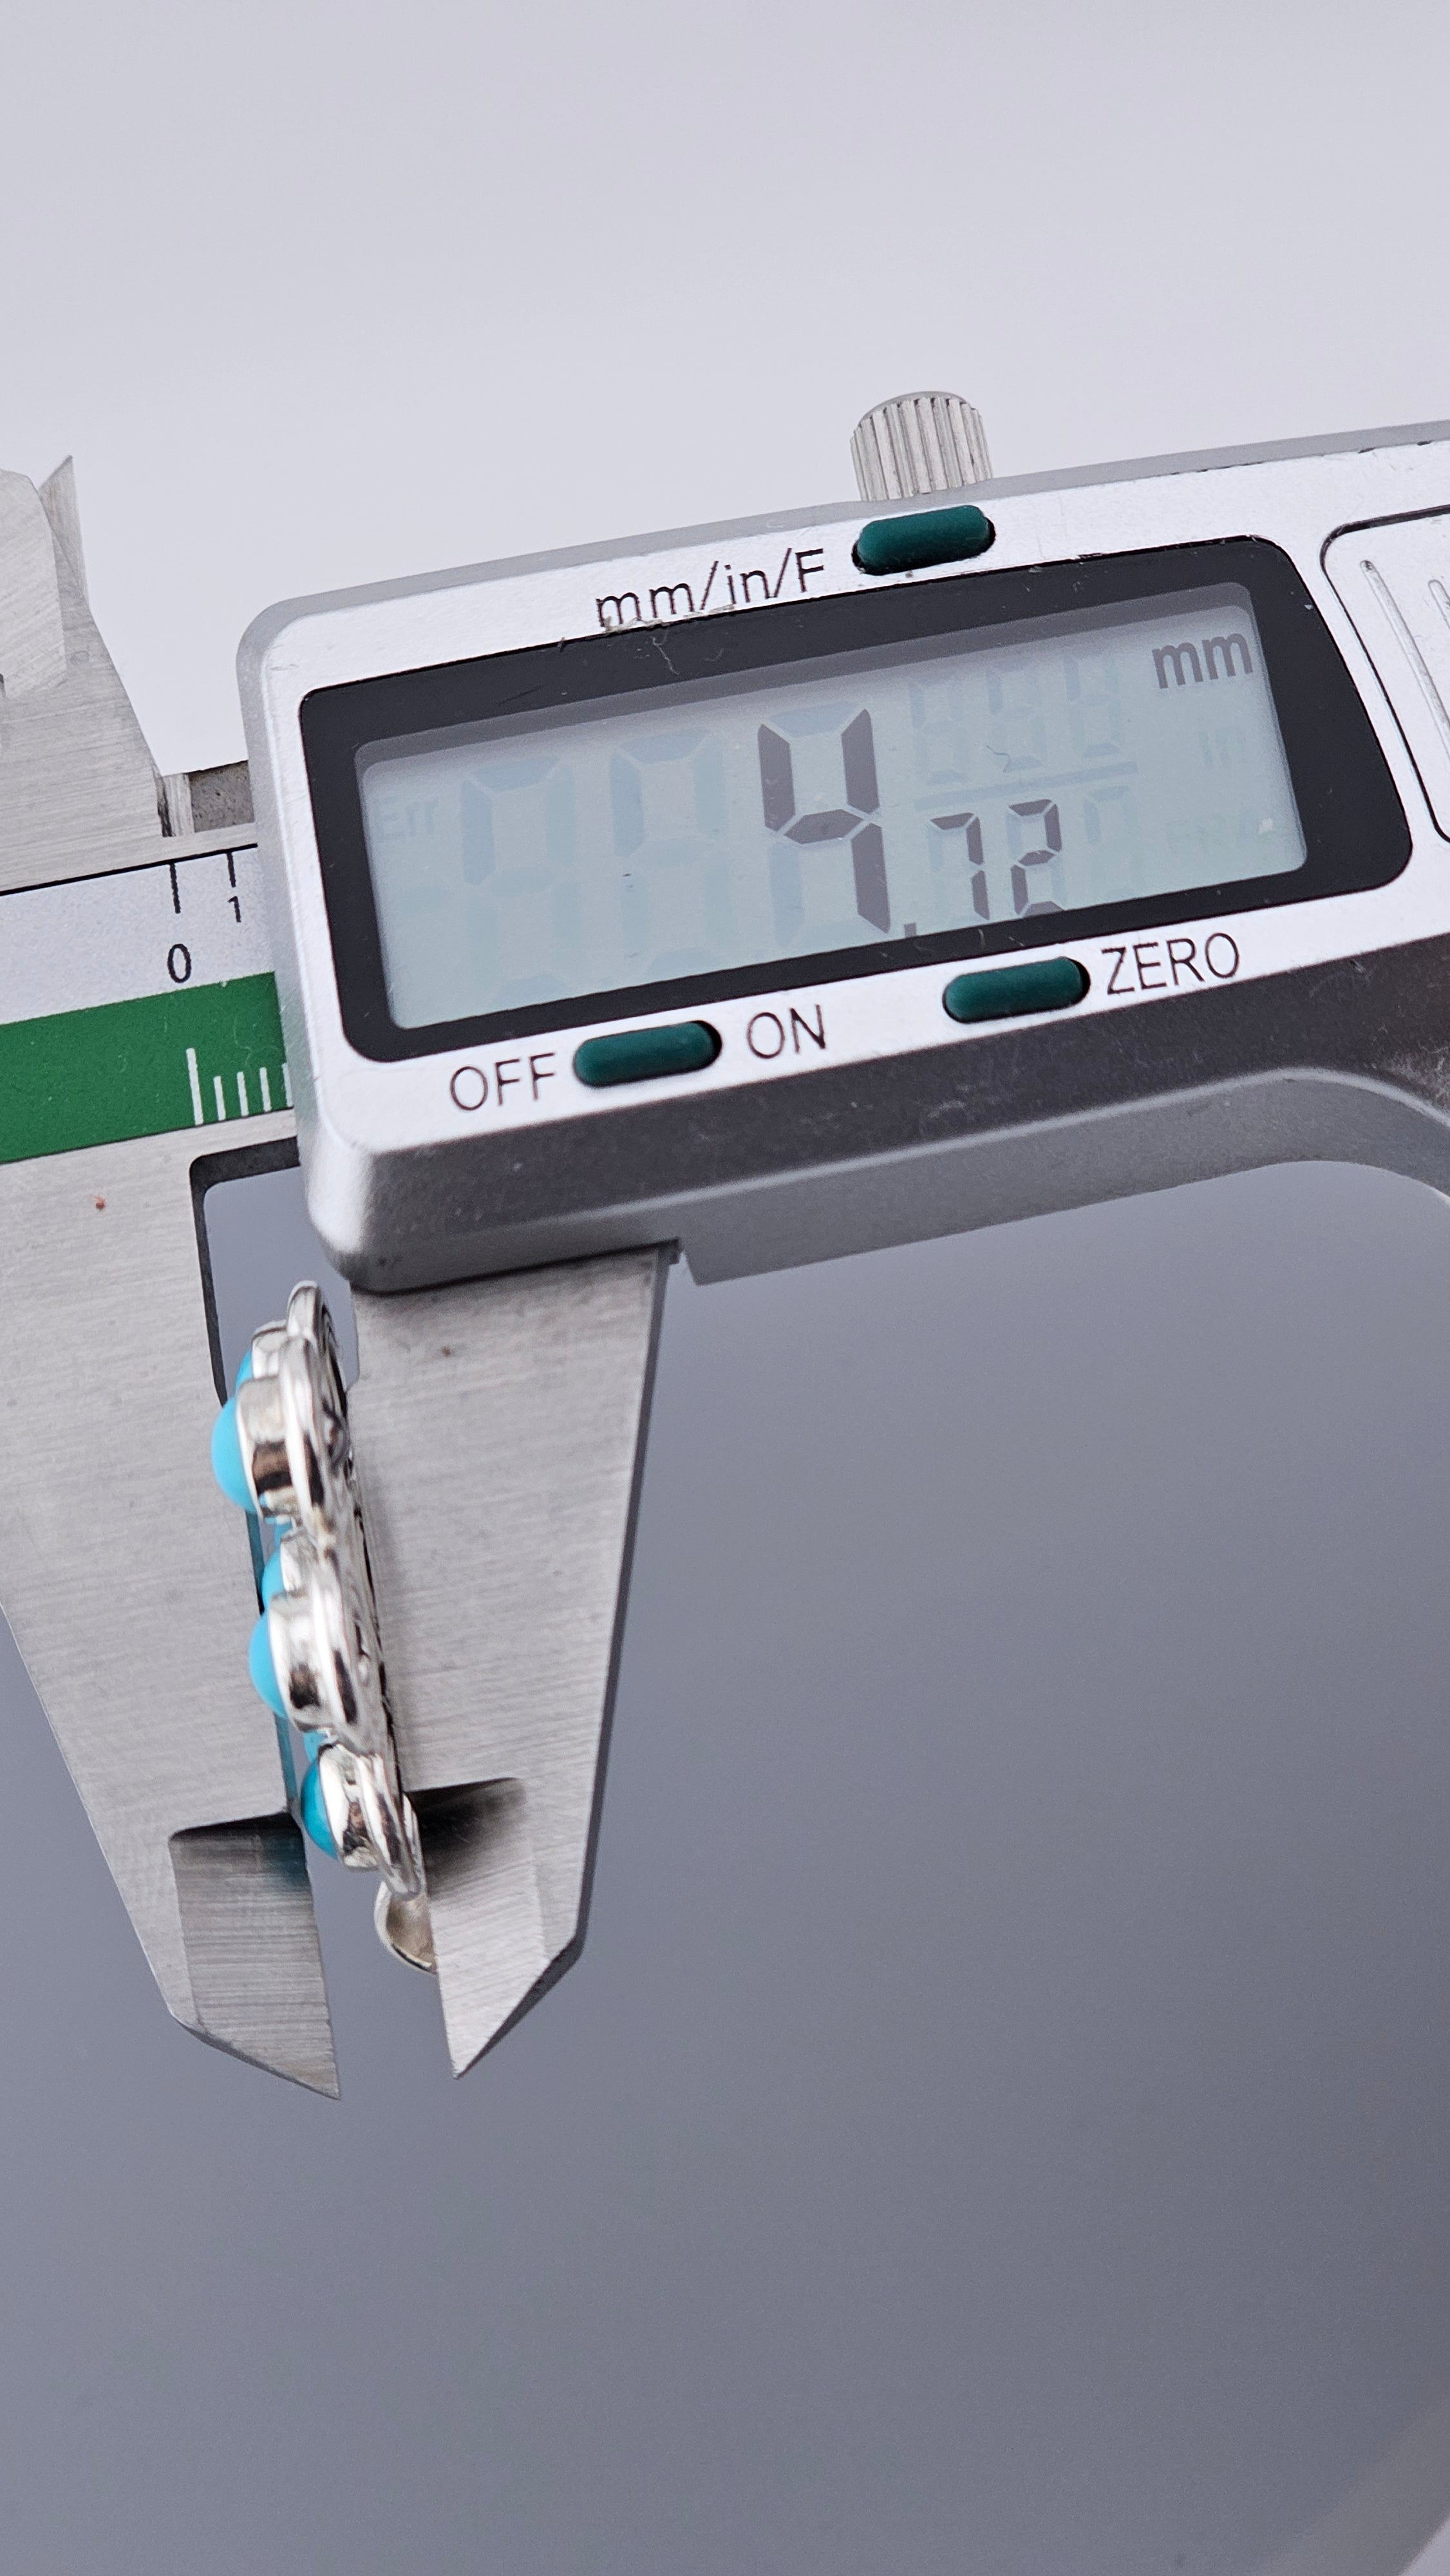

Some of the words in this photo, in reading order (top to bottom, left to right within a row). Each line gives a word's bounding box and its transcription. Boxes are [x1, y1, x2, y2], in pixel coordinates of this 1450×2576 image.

[595, 547, 825, 629] mm/in/F
[1152, 632, 1253, 689] mm
[757, 708, 1066, 938] 4.72
[227, 895, 241, 923] 1
[166, 943, 192, 983] 0
[1100, 932, 1240, 996] ZERO
[746, 1003, 827, 1059] ON
[449, 1052, 557, 1112] OFF
